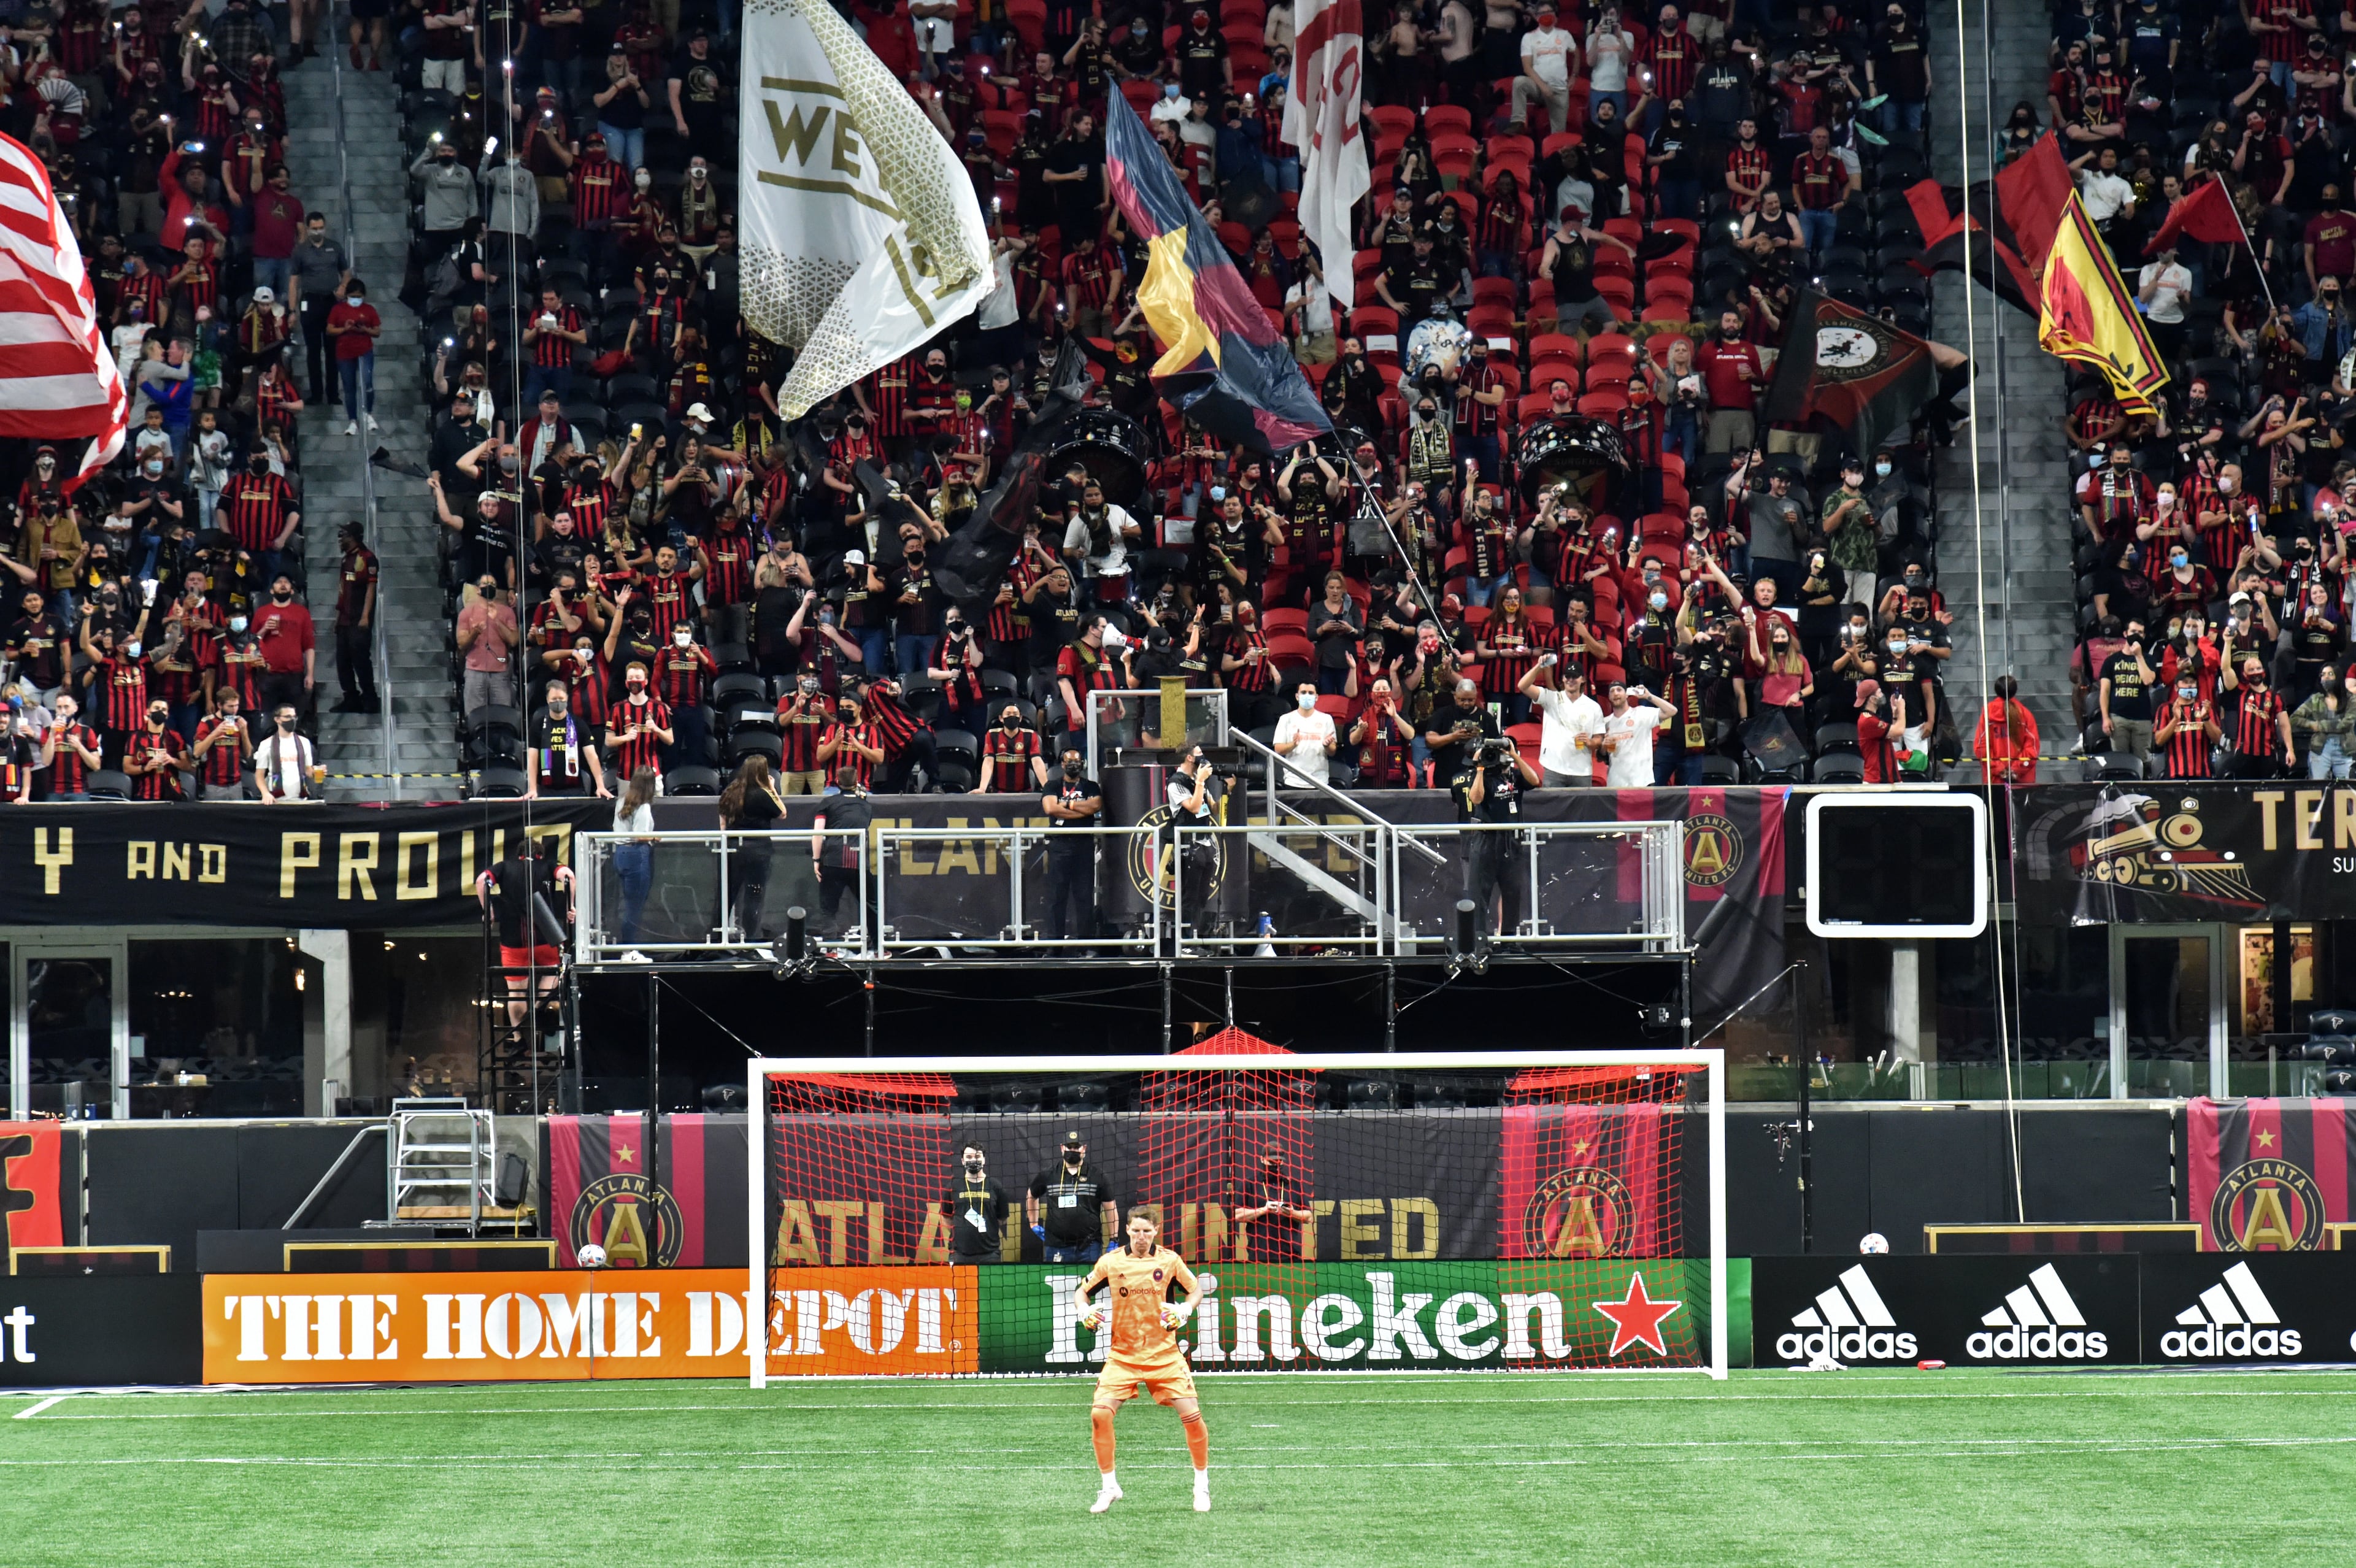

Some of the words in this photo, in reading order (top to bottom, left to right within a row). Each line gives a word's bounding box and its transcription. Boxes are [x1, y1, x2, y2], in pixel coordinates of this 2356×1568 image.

[762, 99, 862, 179] WE
[2114, 659, 2139, 671] KING
[2115, 687, 2139, 698] HERE
[1683, 816, 1732, 834] ATLANTA
[34, 826, 74, 895] Y
[127, 840, 227, 884] AND
[1721, 864, 1735, 878] FC
[587, 1178, 666, 1205] ATLANA
[1542, 1171, 1619, 1201] ATLANTA
[2228, 1163, 2306, 1191] ATLANTA
[224, 1294, 398, 1361] THE
[422, 1291, 661, 1360] HOME
[2160, 1323, 2303, 1357] adidas
[1776, 1325, 1919, 1360] adidas
[1966, 1324, 2109, 1359] adidas
